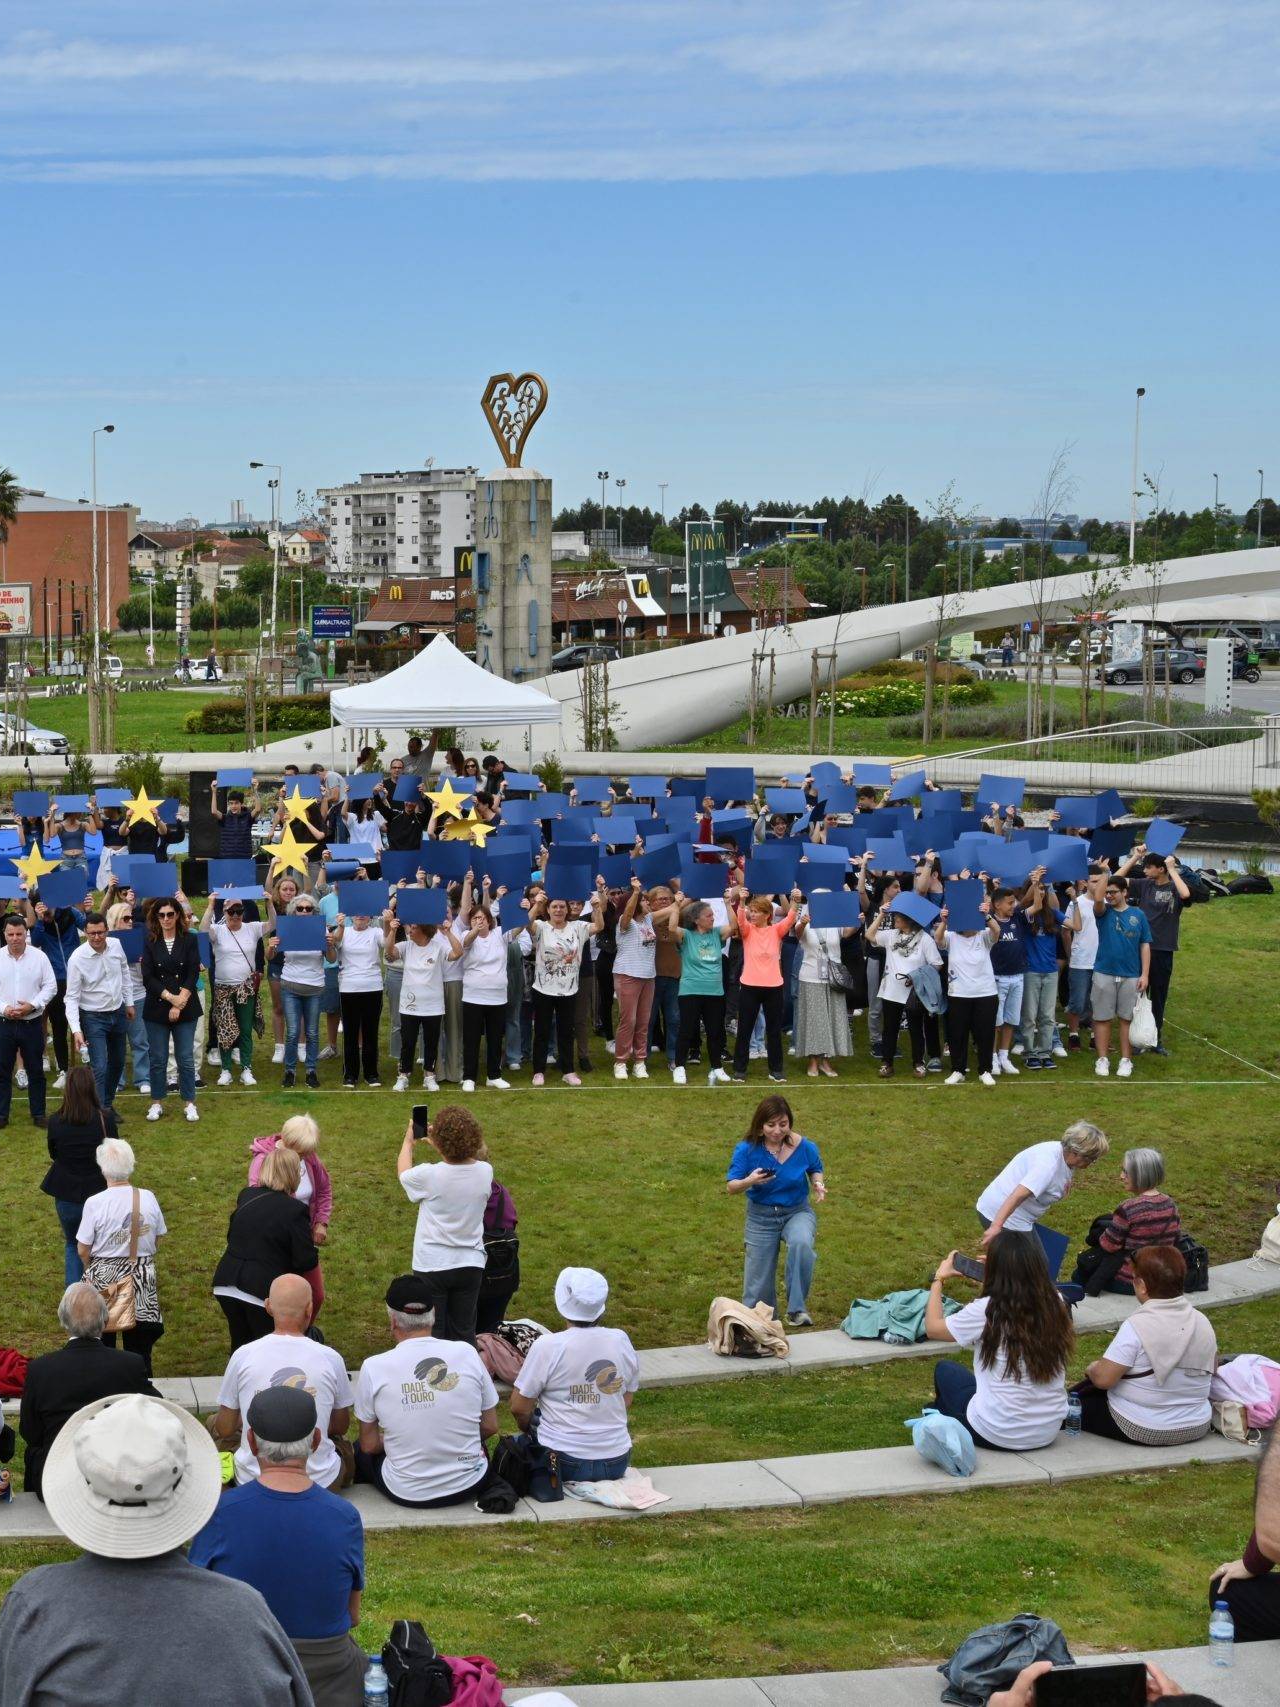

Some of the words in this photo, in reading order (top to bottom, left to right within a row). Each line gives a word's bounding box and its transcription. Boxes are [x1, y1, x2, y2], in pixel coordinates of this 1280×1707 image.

[401, 1381, 427, 1393] IDADE
[569, 1383, 595, 1395] IDADE
[402, 1391, 435, 1405] d'OURO
